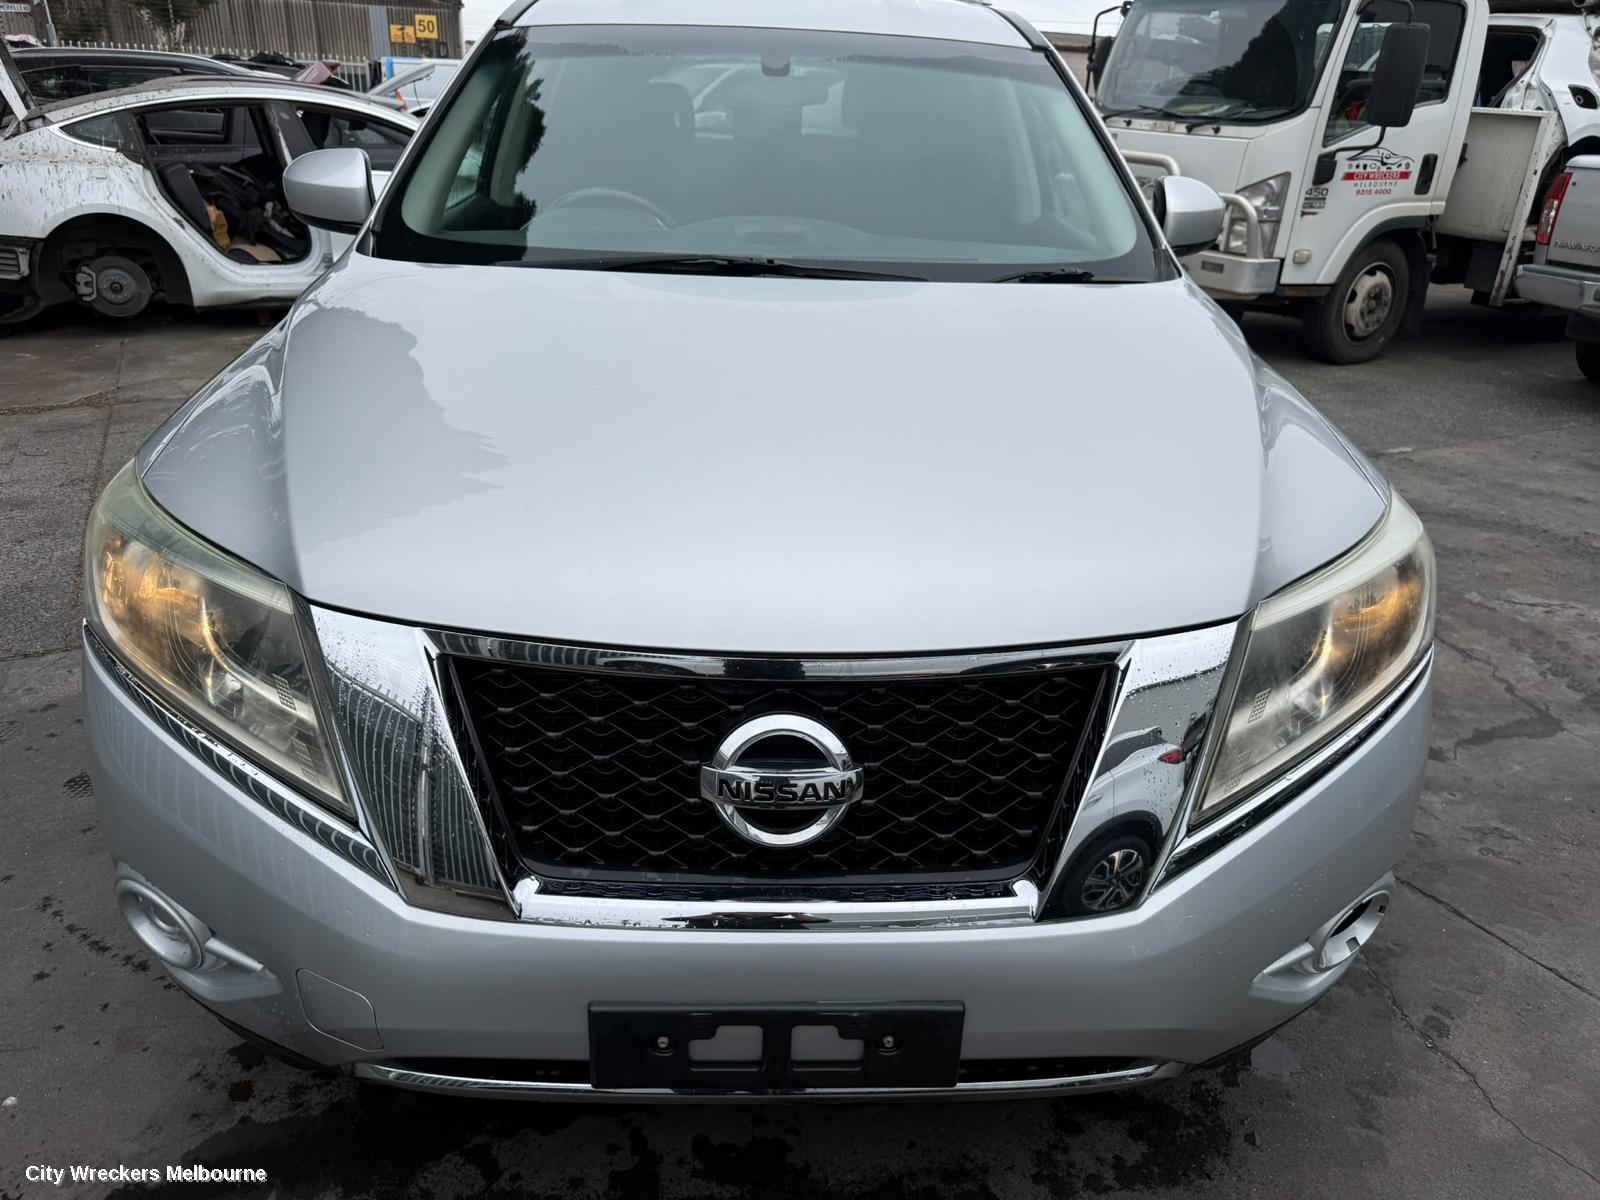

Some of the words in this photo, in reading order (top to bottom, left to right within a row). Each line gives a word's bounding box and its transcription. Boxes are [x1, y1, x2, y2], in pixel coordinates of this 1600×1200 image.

[418, 19, 435, 33] 50
[1354, 171, 1369, 180] CITY
[1368, 171, 1400, 180] WRECKERS
[1305, 187, 1329, 197] 450
[1355, 188, 1371, 196] 9315
[1374, 188, 1392, 196] 4000
[718, 778, 847, 803] NISSAN
